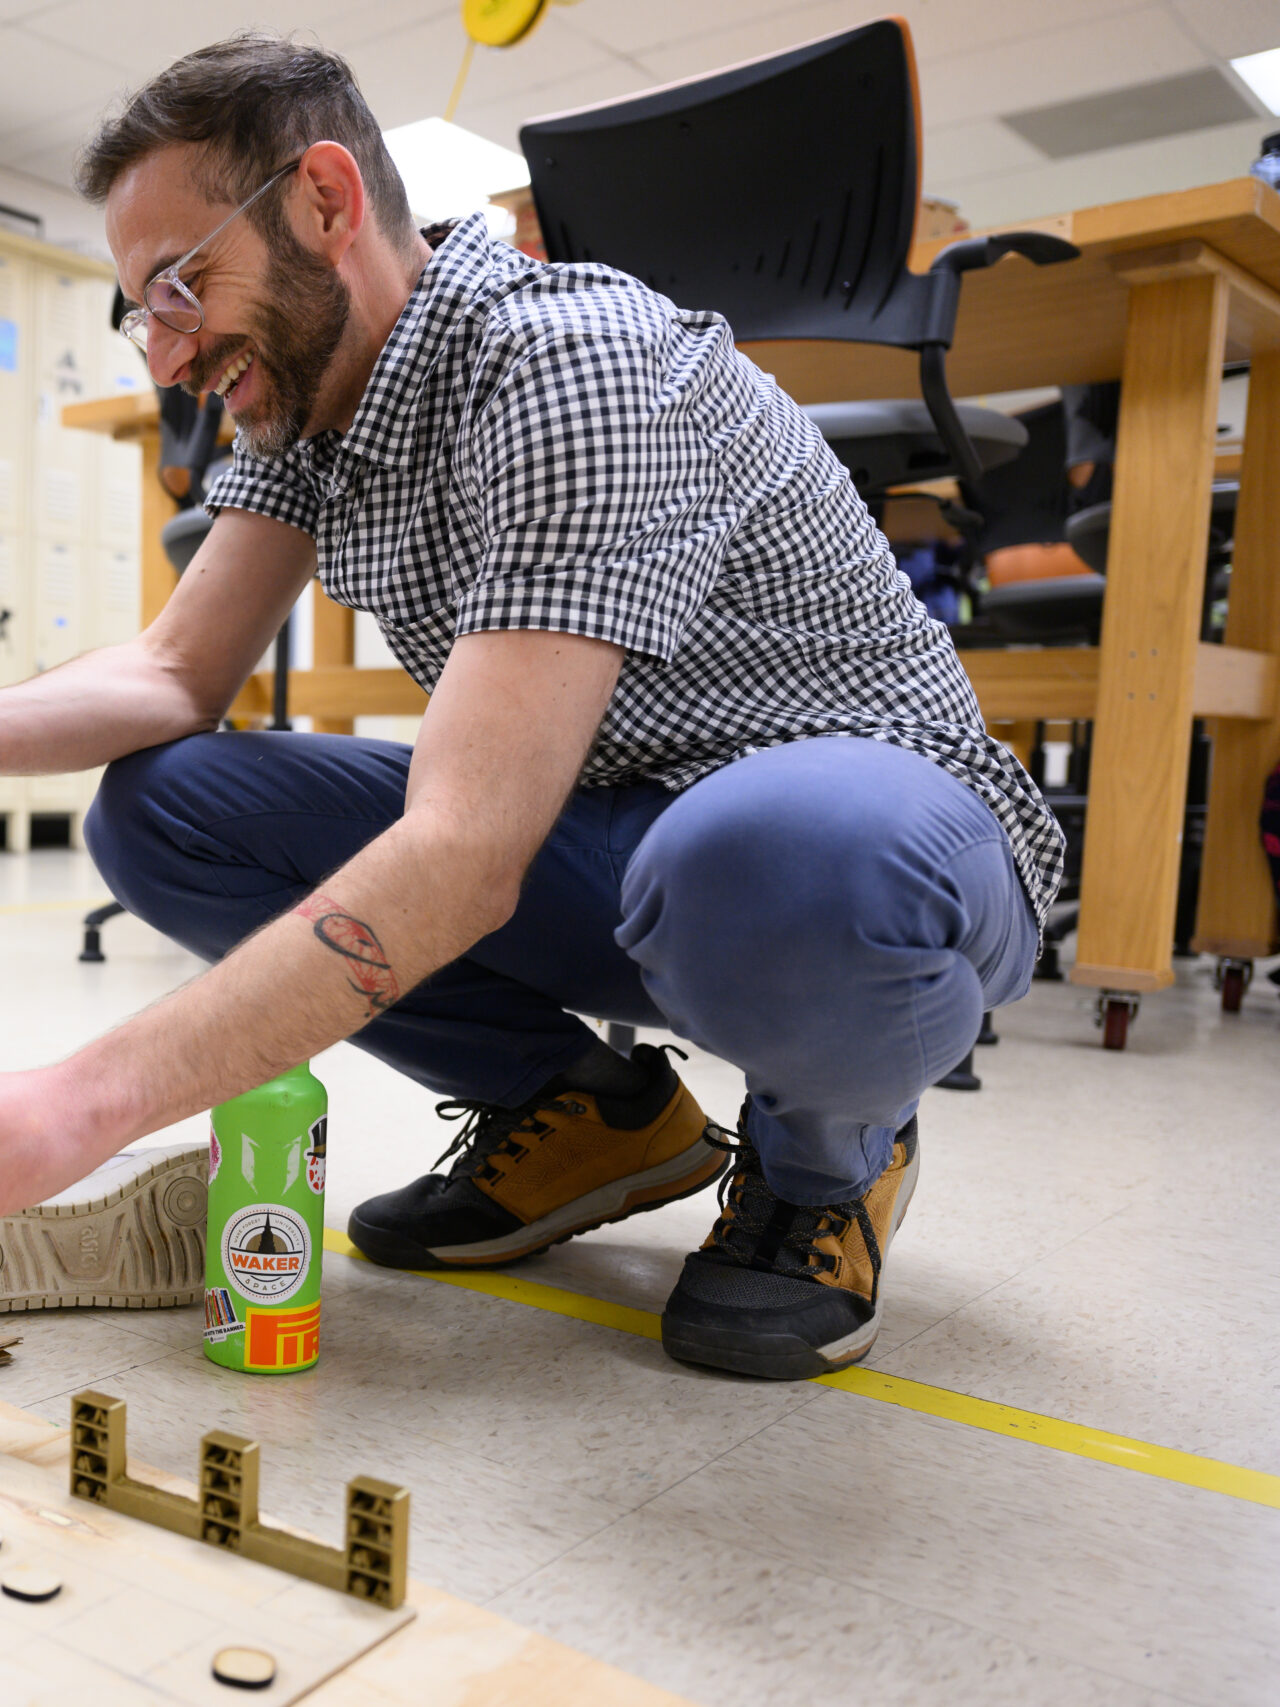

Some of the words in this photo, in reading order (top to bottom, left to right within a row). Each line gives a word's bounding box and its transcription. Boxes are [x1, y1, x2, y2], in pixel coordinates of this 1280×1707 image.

[234, 1228, 243, 1243] WAKE
[242, 1218, 261, 1229] FOREST
[275, 1219, 300, 1246] UNIVERSITY
[231, 1252, 300, 1271] WAKER
